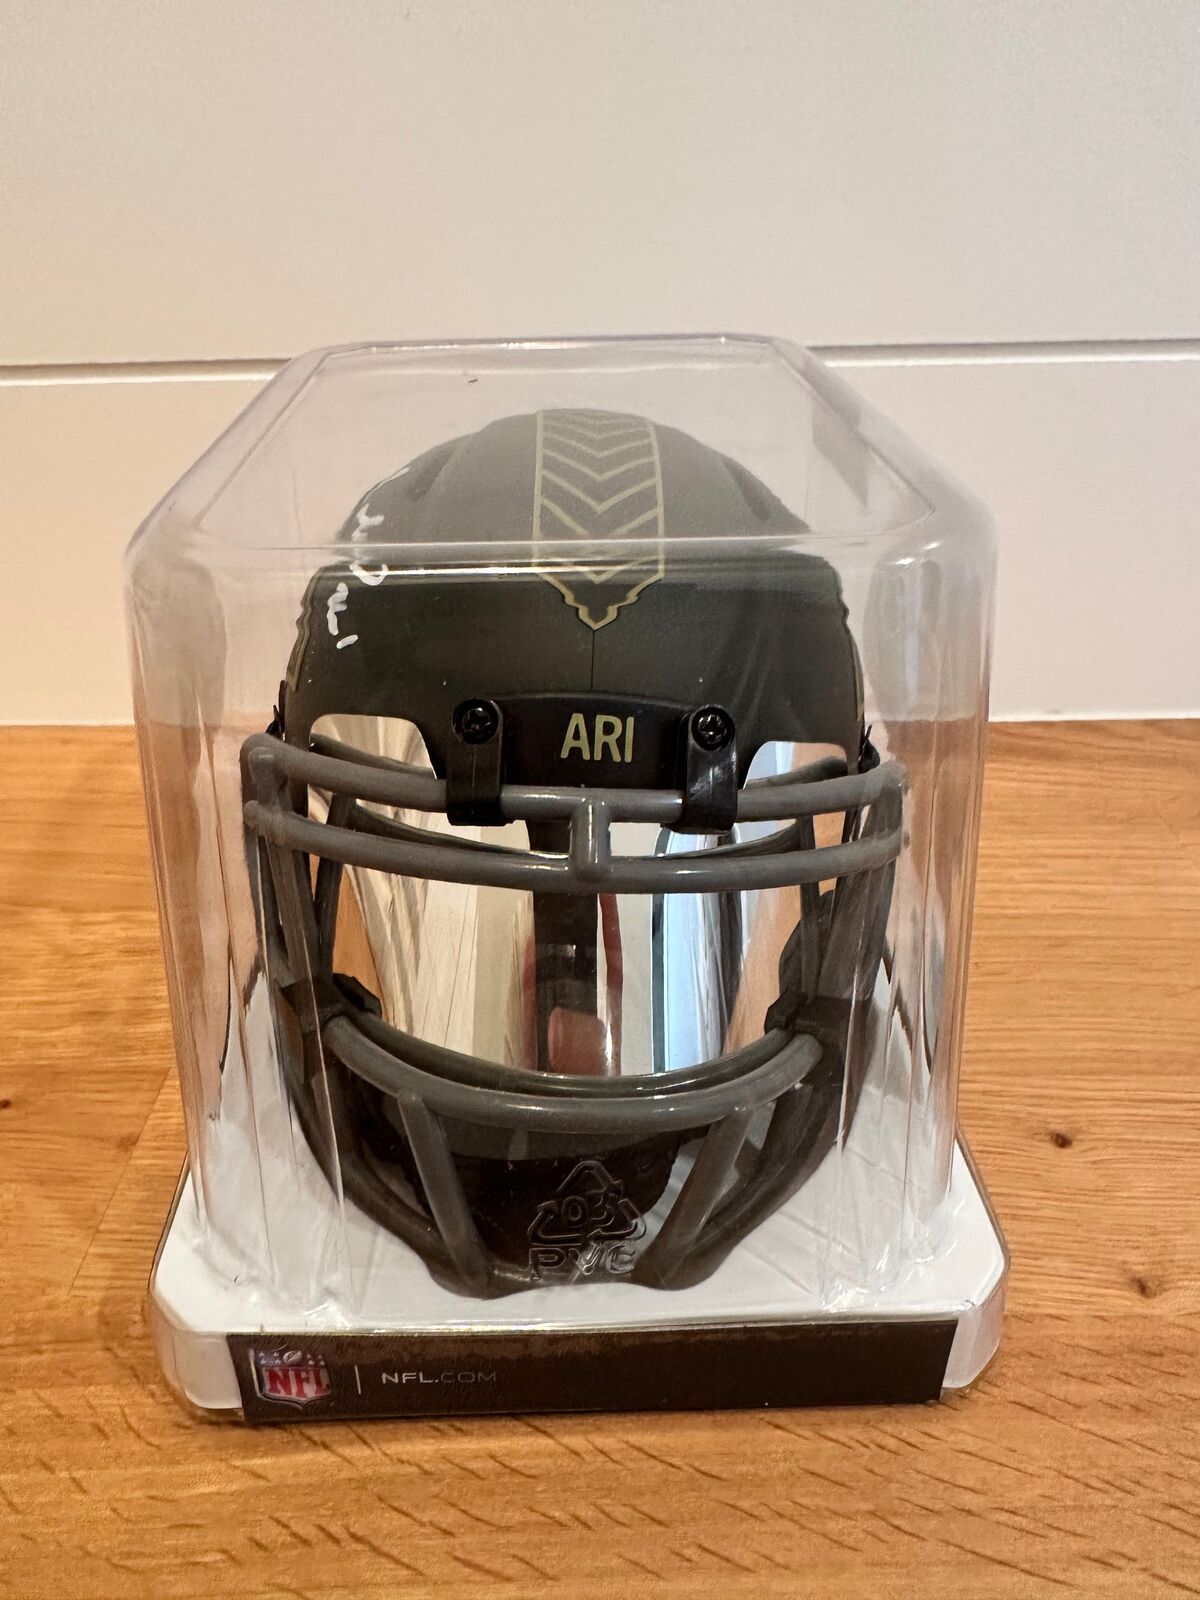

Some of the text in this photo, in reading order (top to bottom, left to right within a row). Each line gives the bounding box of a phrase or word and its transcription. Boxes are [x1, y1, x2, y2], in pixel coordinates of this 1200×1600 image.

[560, 712, 635, 763] ARI
[264, 1366, 331, 1398] NFL
[381, 1370, 497, 1385] NFL.COM
